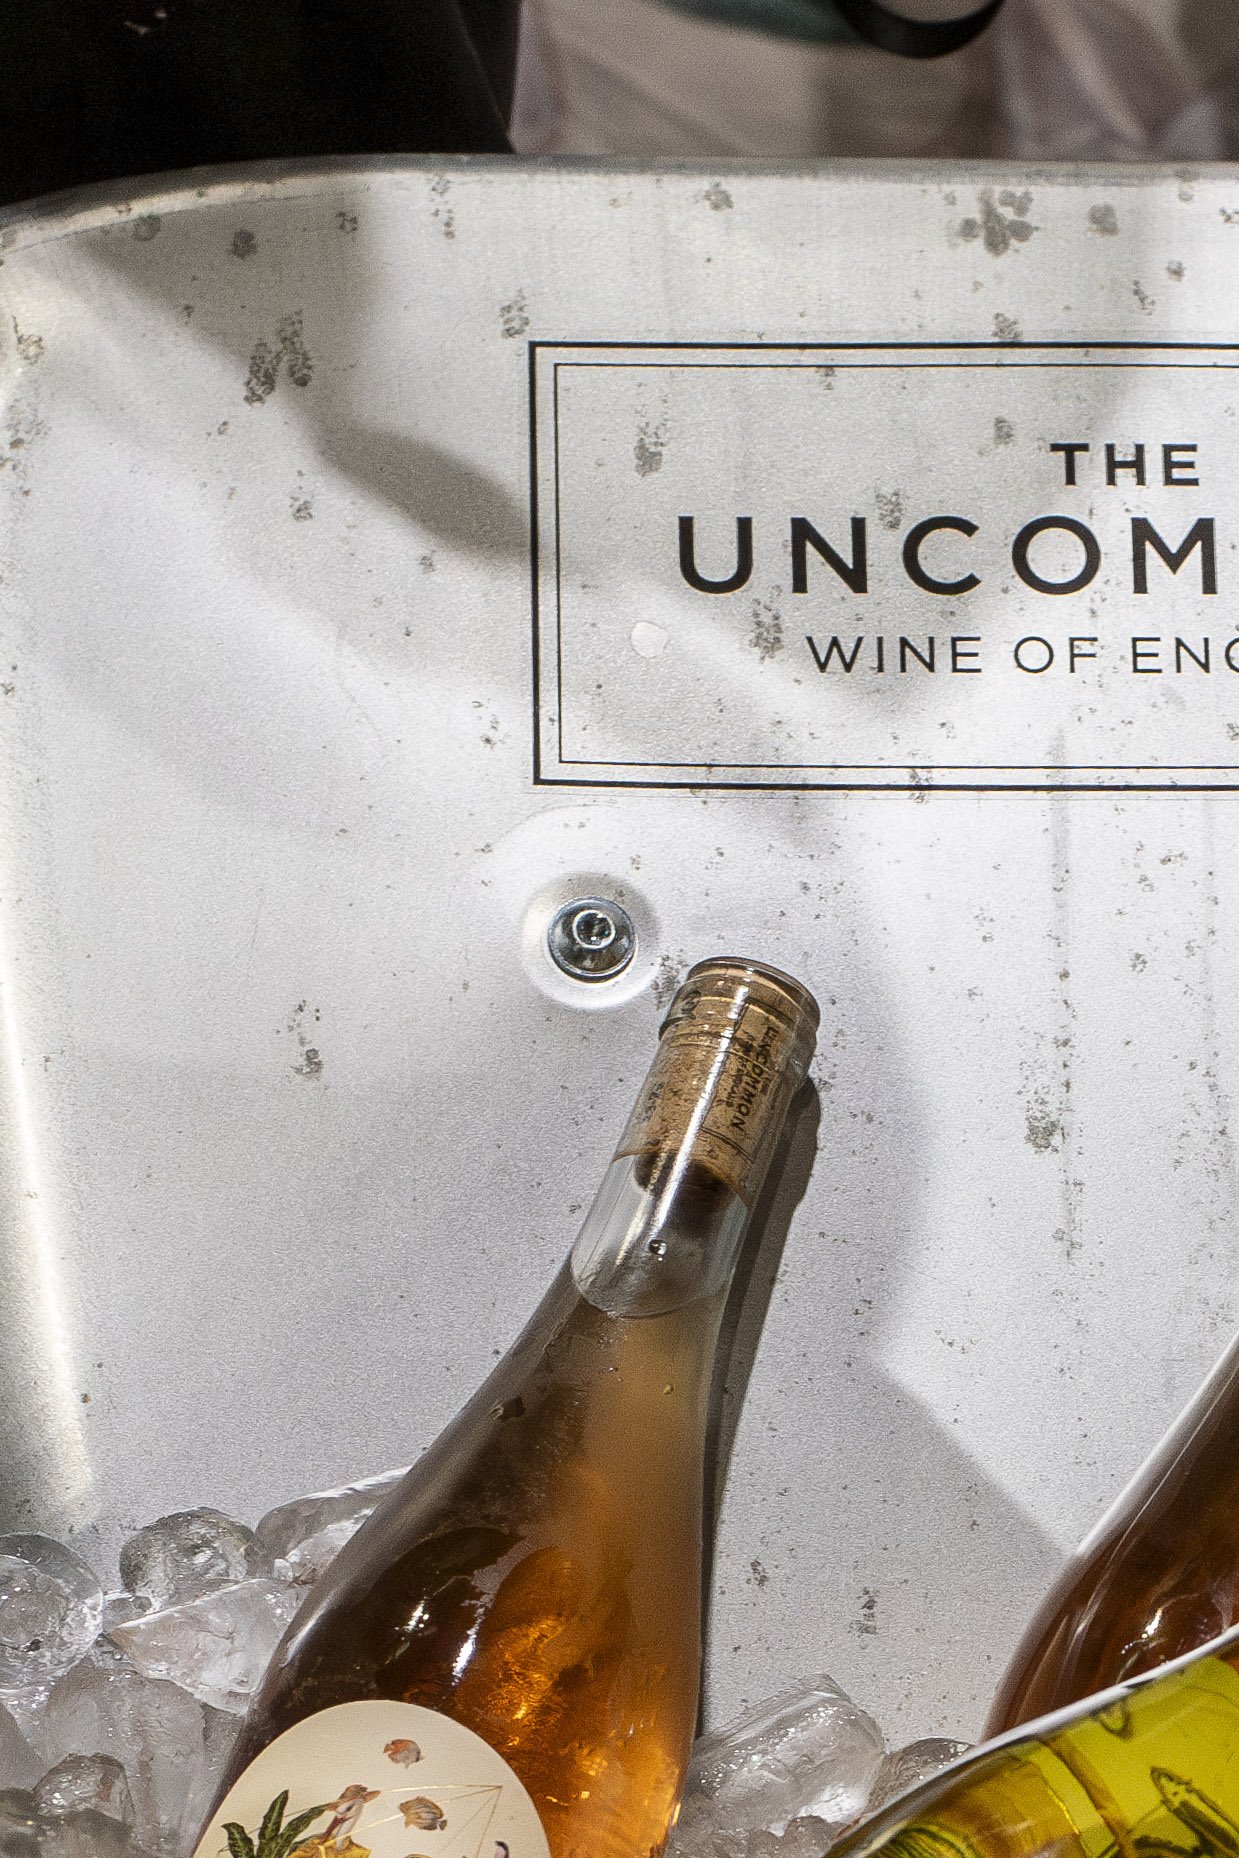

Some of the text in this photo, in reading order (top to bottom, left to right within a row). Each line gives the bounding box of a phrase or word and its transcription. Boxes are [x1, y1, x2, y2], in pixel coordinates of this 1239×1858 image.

[1049, 442, 1199, 486] THE
[805, 636, 982, 674] WINE
[1014, 636, 1098, 674] OF
